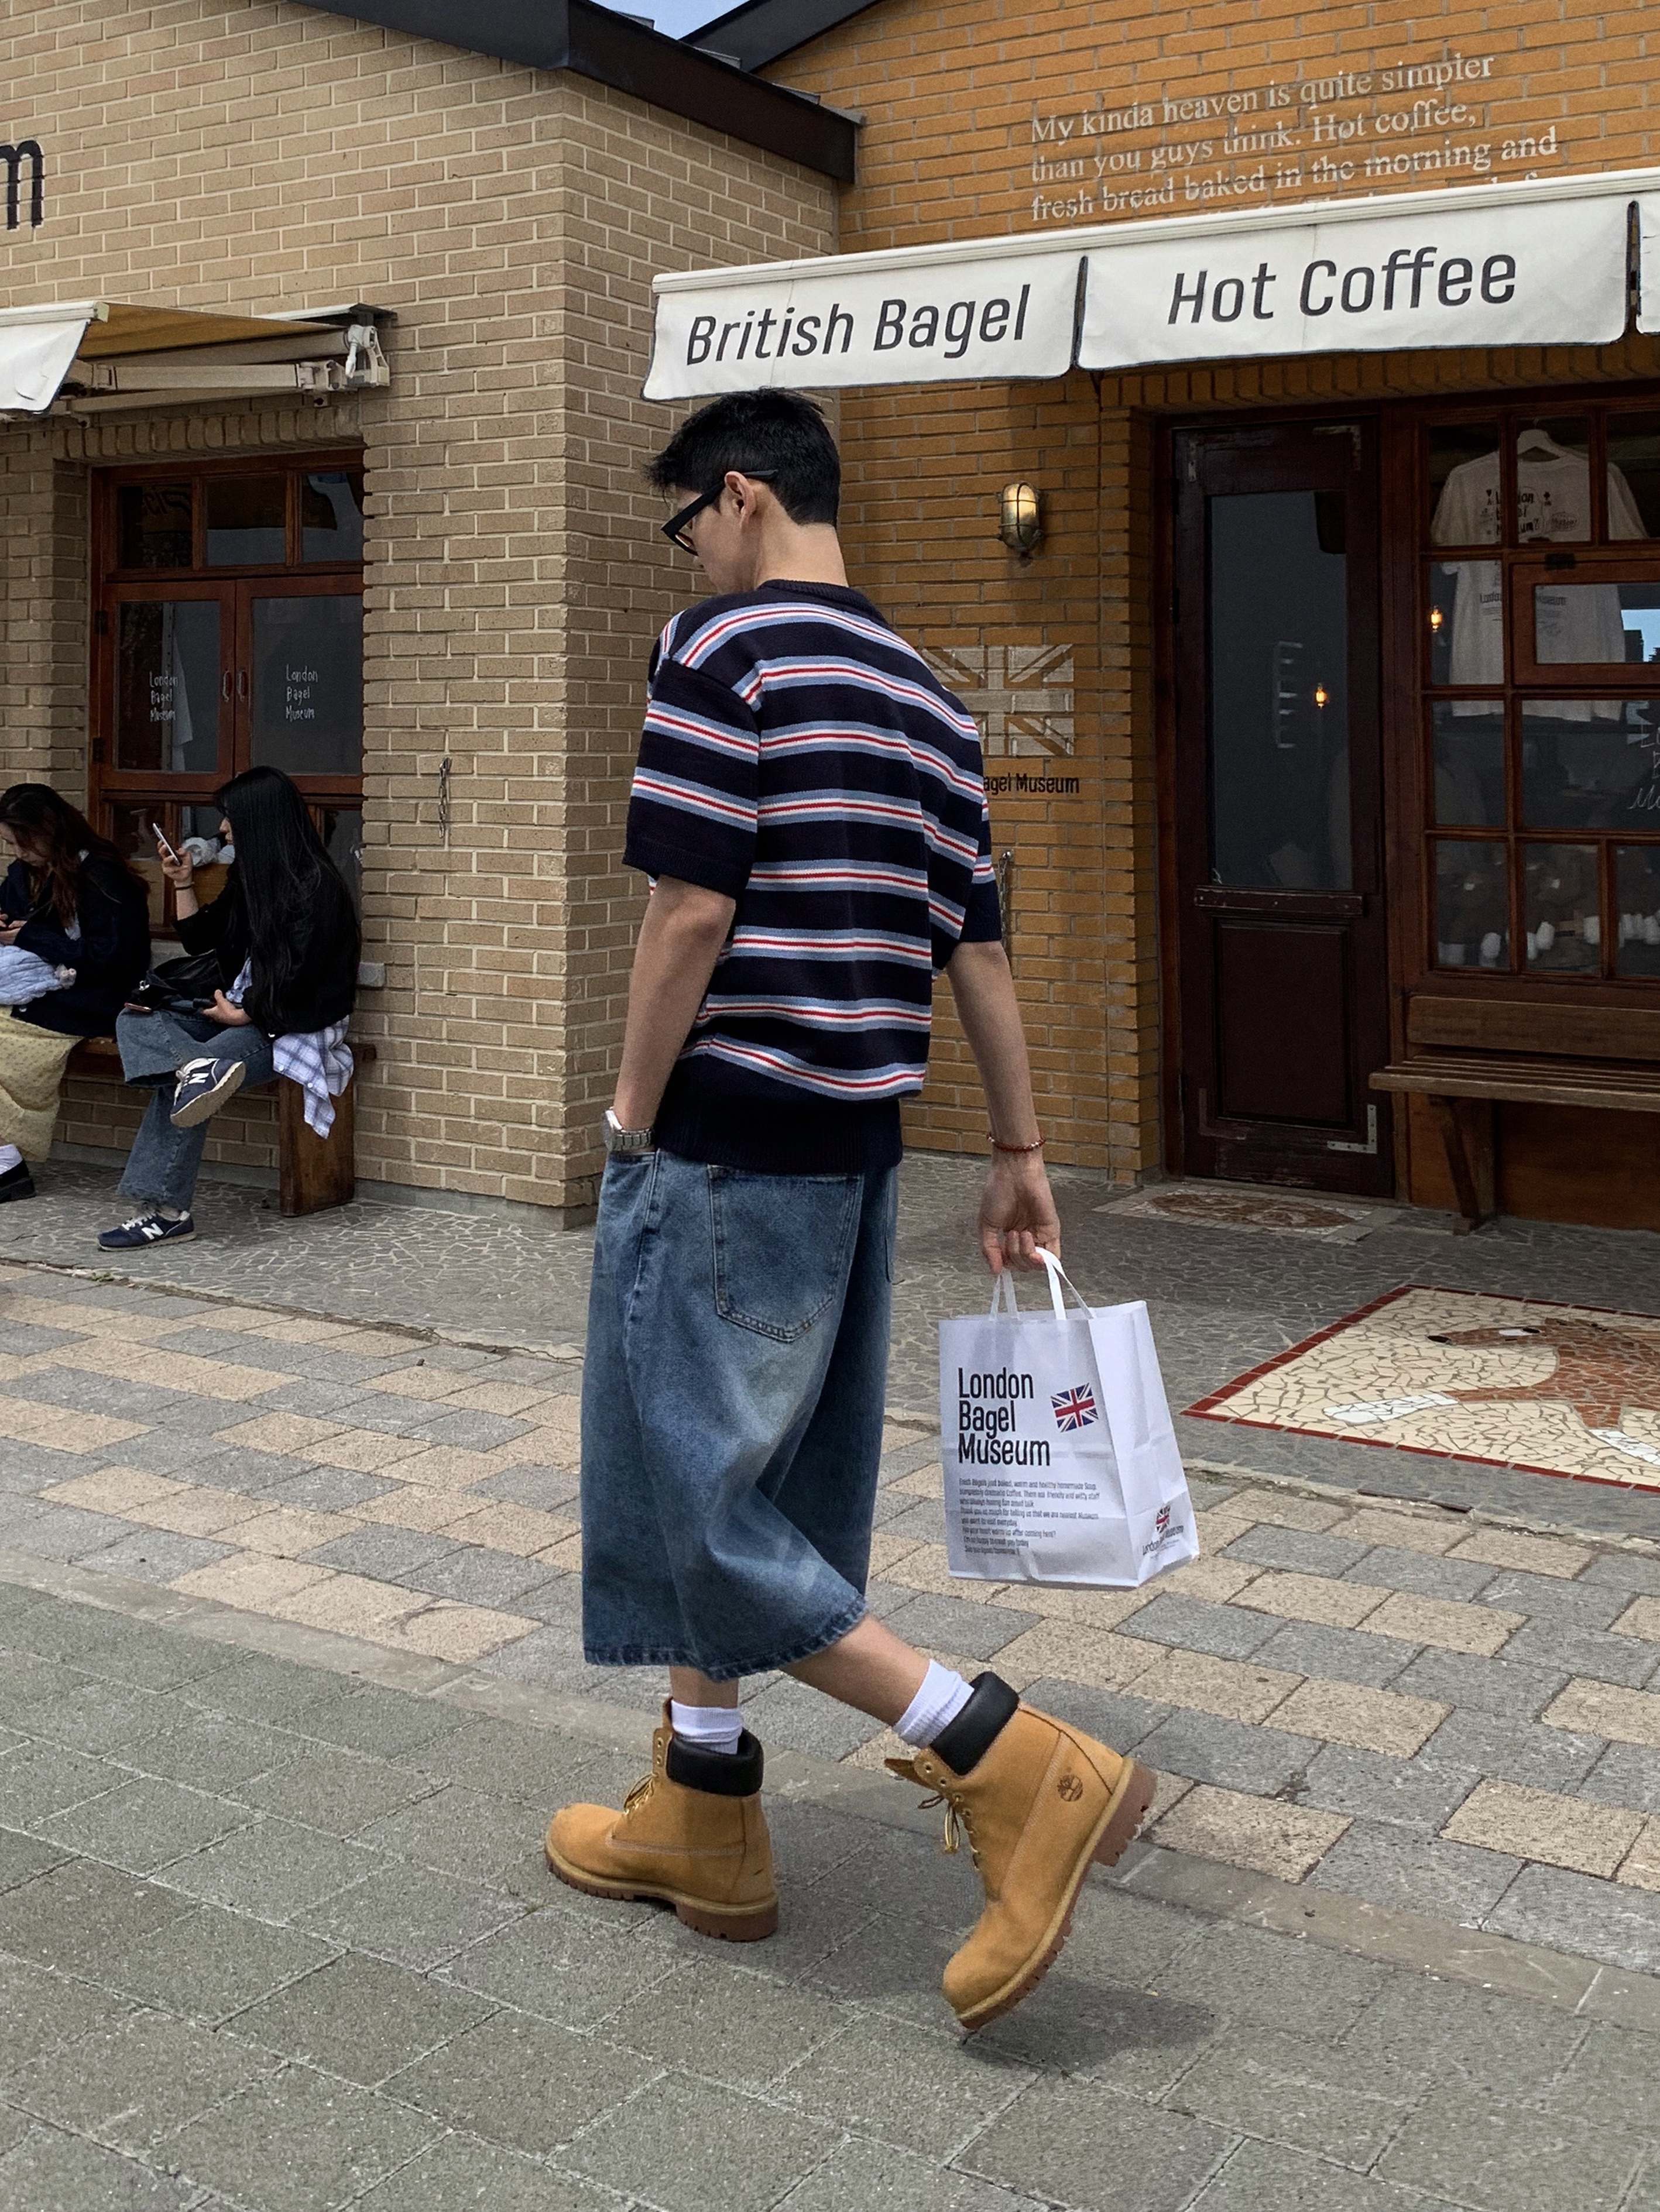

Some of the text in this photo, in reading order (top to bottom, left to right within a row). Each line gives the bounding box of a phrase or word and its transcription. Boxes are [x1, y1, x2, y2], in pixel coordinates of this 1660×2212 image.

[1032, 53, 1494, 146] My kinda heaven is quite simpler
[1031, 98, 1476, 183] than you guys think. Hot coffee,
[1032, 190, 1094, 221] fresh
[1103, 177, 1174, 212] bread
[1184, 165, 1266, 201] baked
[1274, 162, 1302, 189] in
[1311, 155, 1355, 183] the
[1364, 138, 1492, 177] morning
[1501, 125, 1558, 161] and
[1168, 246, 1517, 325] Hot Coffee
[687, 284, 1031, 366] British Bagel
[149, 671, 178, 688] London
[286, 664, 318, 683] London
[150, 689, 172, 707] Bagel
[287, 686, 310, 706] Bagel
[150, 709, 176, 722] Museum
[286, 705, 315, 722] Museum
[983, 772, 1079, 795] agel Museum
[958, 1367, 1034, 1399] London
[959, 1400, 1016, 1439] Bagel
[958, 1433, 1051, 1466] Museum
